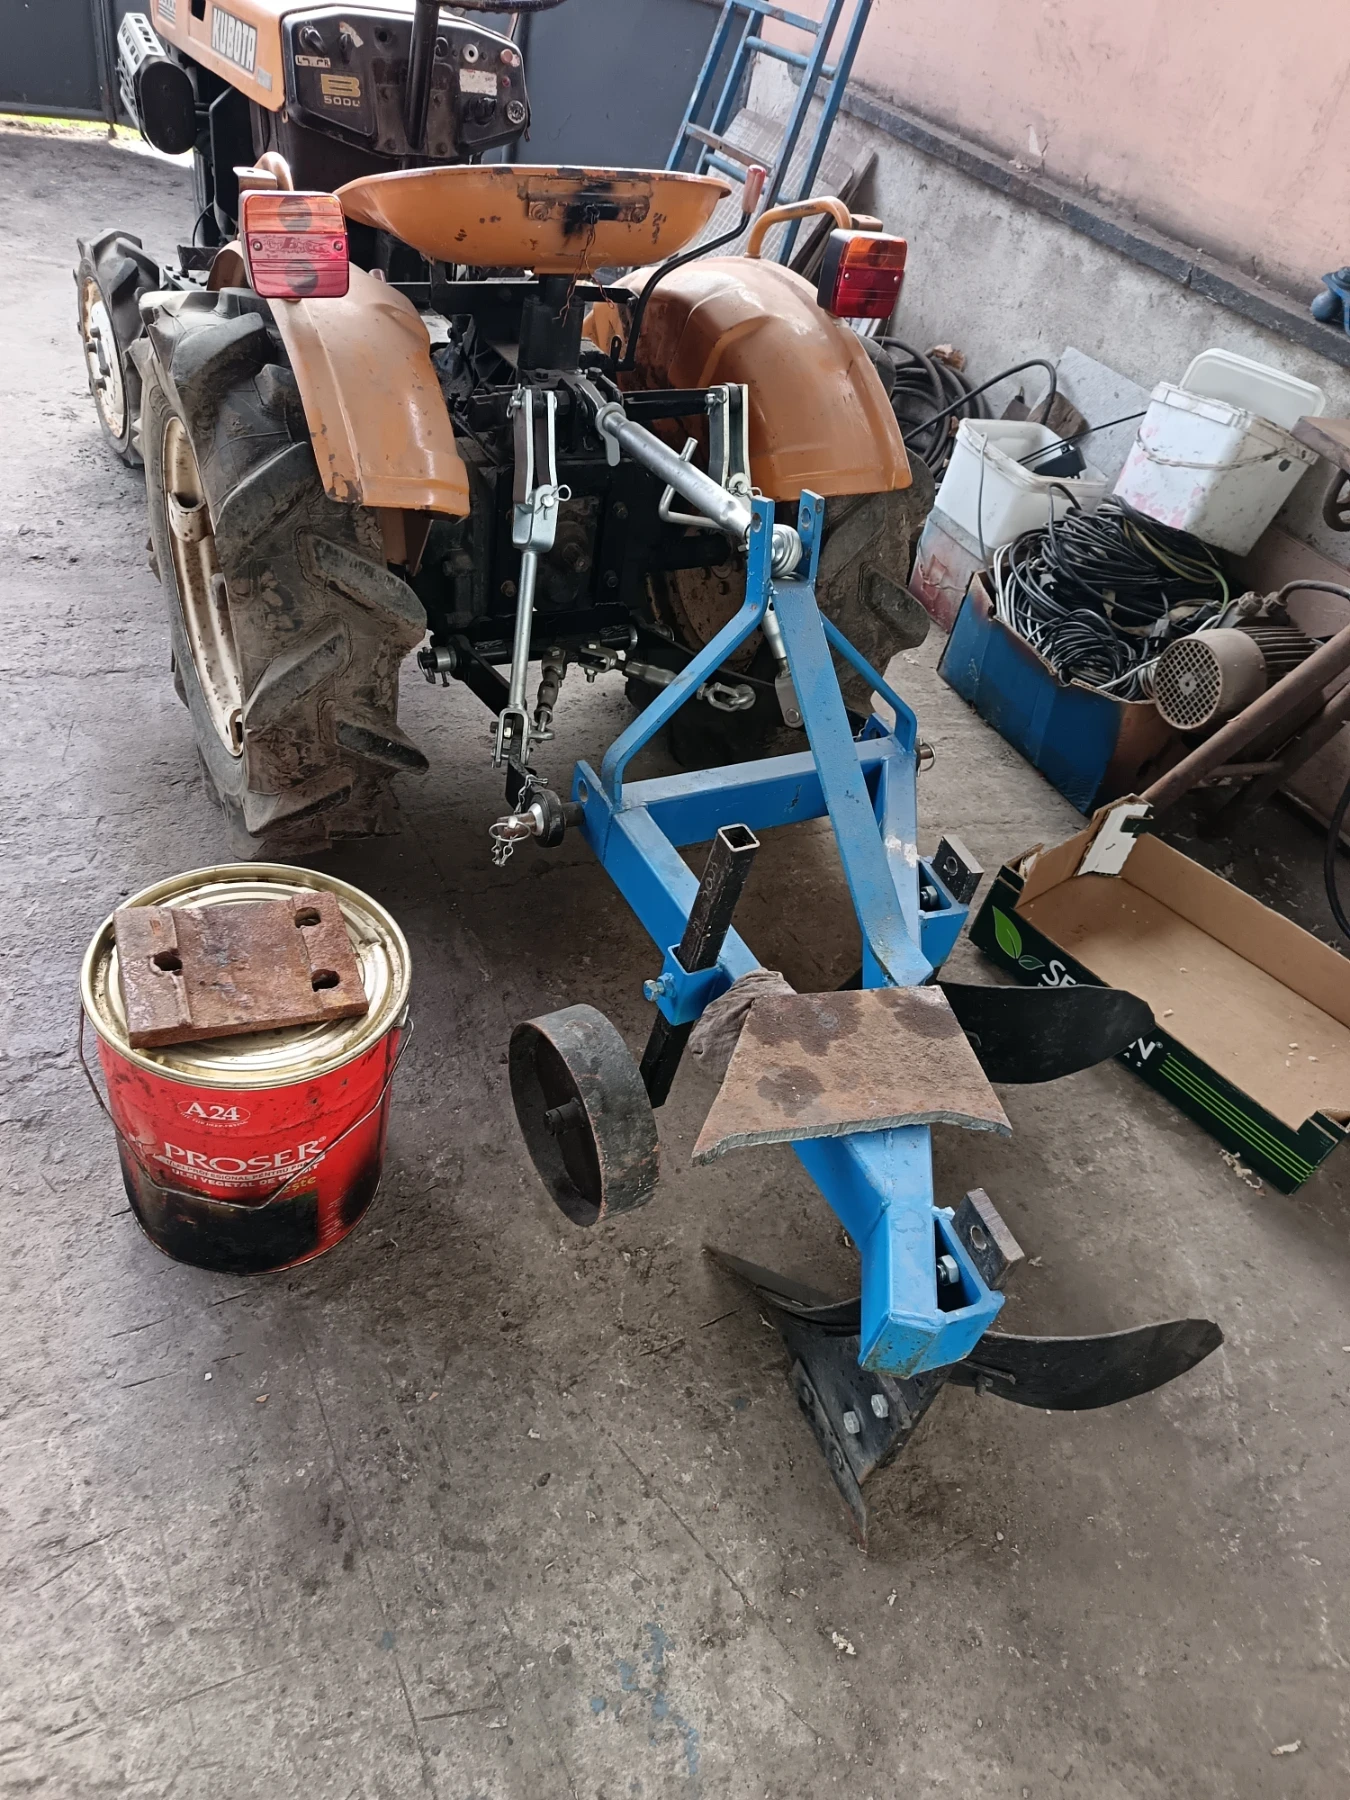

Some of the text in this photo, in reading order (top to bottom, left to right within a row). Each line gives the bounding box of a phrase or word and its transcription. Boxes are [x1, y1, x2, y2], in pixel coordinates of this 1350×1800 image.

[212, 7, 257, 73] KUBOTA
[185, 1102, 240, 1121] A24
[163, 1140, 323, 1173] PROSER
[172, 1167, 197, 1181] ULEI
[200, 1177, 256, 1188] VEGETAL
[259, 1177, 276, 1186] DE
